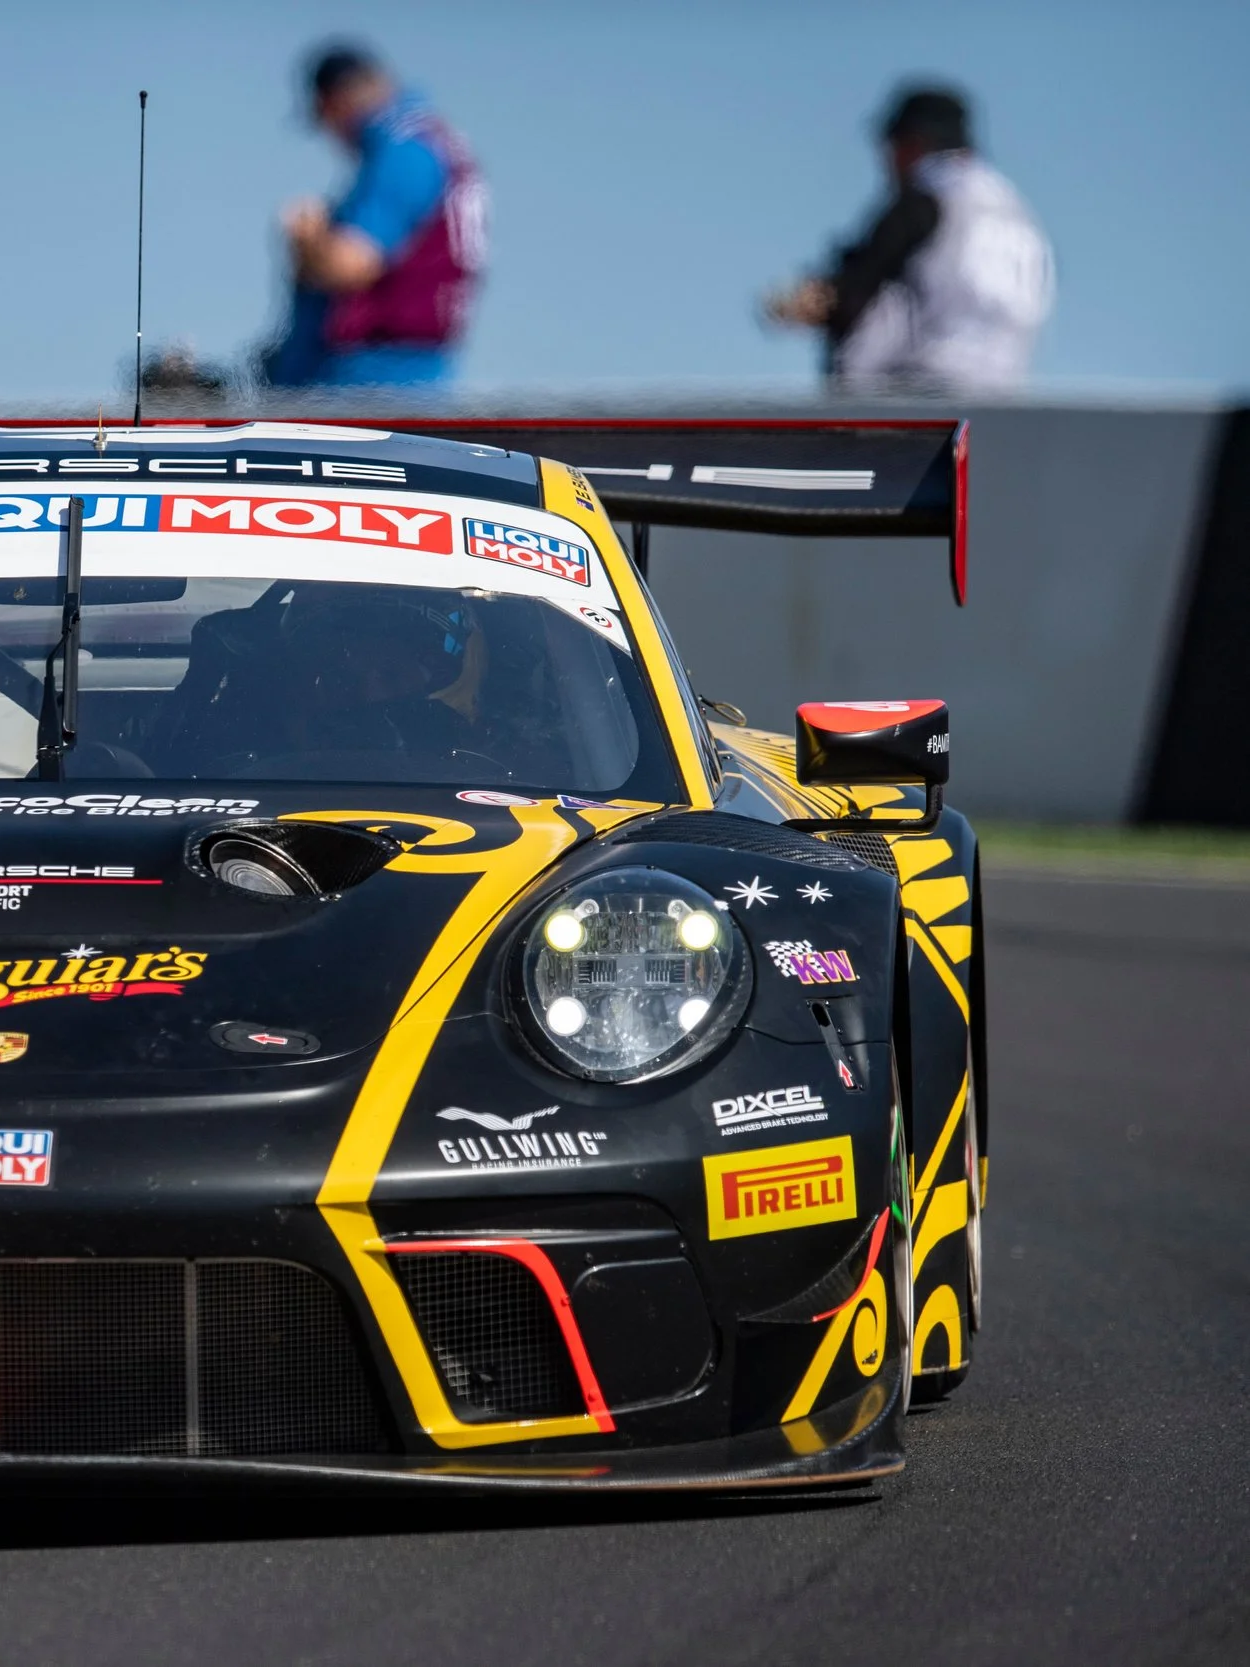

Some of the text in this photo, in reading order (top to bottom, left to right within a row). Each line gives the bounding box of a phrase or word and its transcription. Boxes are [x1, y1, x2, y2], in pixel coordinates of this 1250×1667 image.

[171, 497, 443, 545] MOLY
[473, 522, 579, 564] LIQUI
[475, 538, 584, 579] MOLY
[13, 806, 75, 815] Ice
[86, 805, 253, 815] Blasting
[790, 950, 857, 984] KW
[12, 982, 114, 1003] Since 1901
[712, 1085, 823, 1118] DIXCEL
[721, 1122, 762, 1136] ADVANCED
[762, 1117, 787, 1129] BRAKE
[437, 1131, 600, 1164] GULLWING
[518, 1157, 582, 1169] INSURANCE
[722, 1154, 845, 1221] PIRELLI
